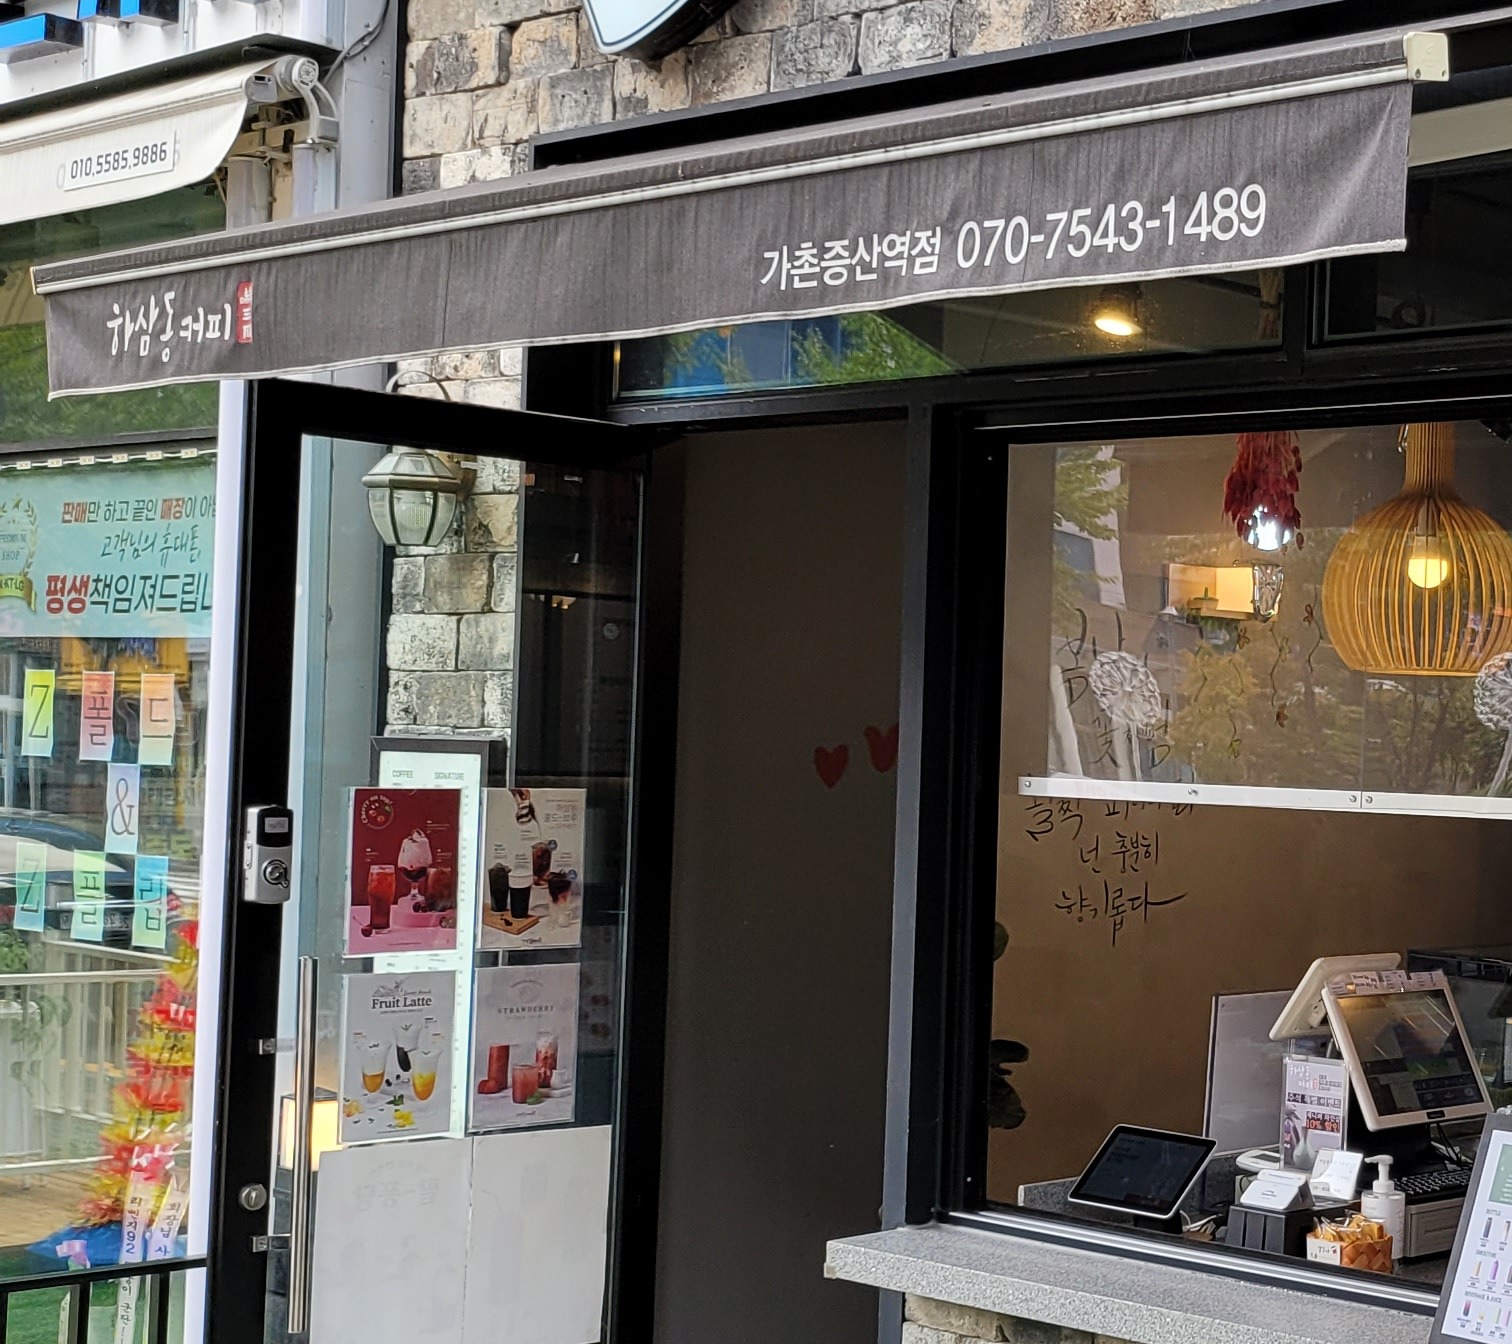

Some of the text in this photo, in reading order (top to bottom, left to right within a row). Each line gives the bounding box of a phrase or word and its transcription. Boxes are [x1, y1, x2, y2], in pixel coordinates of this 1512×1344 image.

[760, 183, 1267, 292] 가촌증산역점 070-7543-1489
[103, 500, 130, 523] 하고
[100, 528, 158, 563] 고객님의
[371, 996, 432, 1010] Fruit Latte
